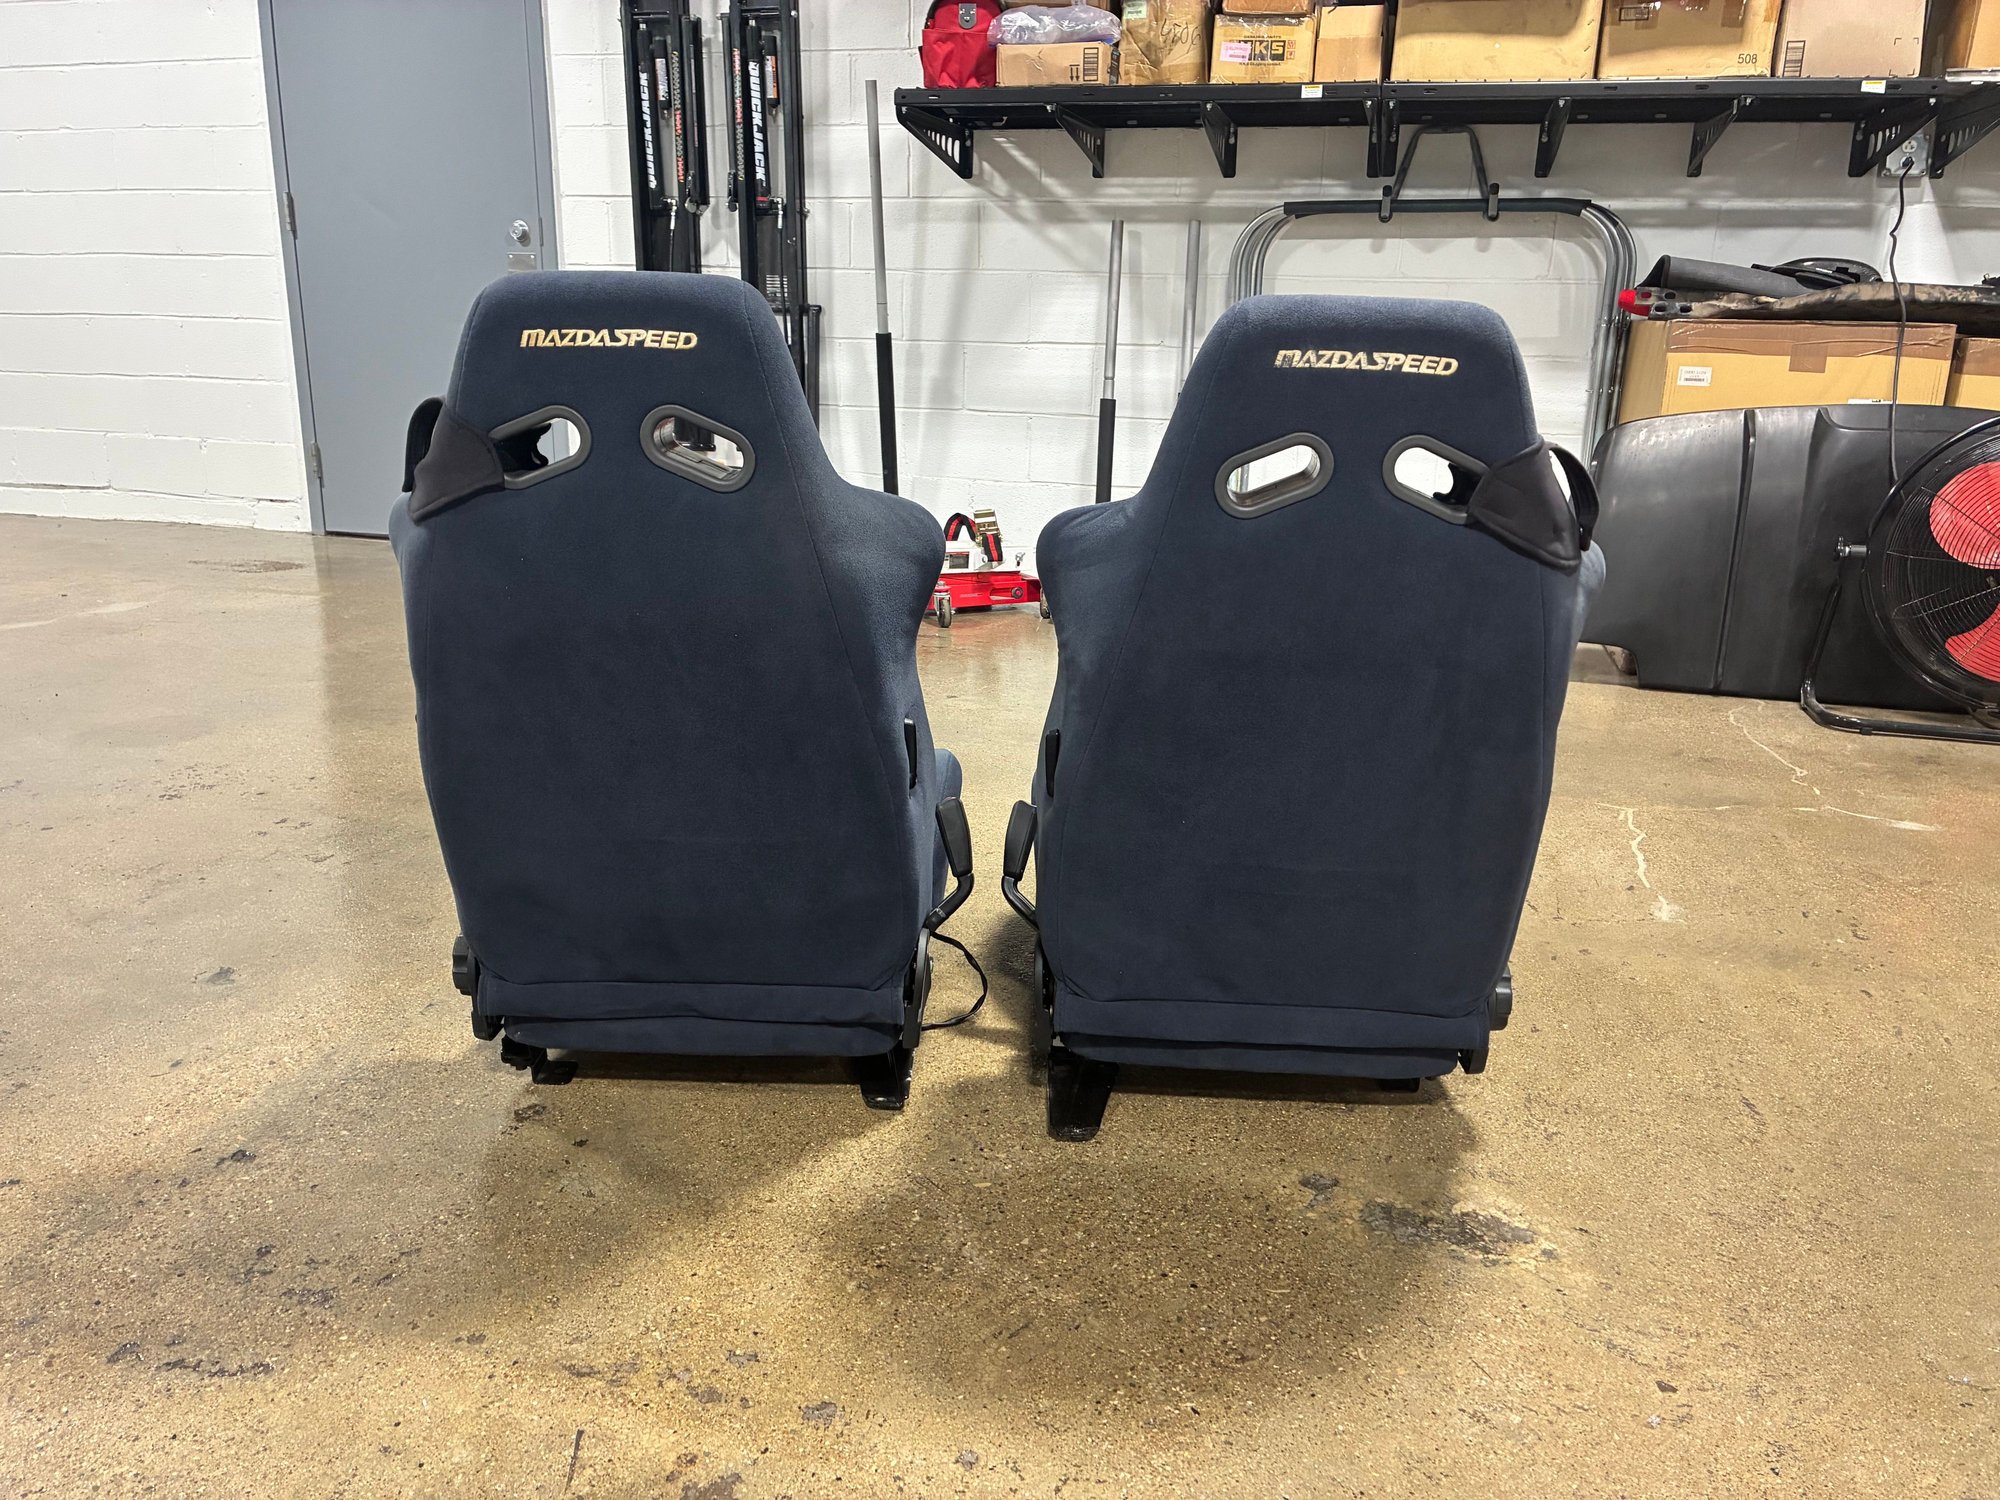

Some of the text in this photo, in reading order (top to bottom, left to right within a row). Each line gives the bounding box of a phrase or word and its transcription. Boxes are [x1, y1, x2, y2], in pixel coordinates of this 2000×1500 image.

[1737, 53, 1758, 65] 508
[639, 71, 657, 189] QUICKJACK
[748, 61, 766, 181] QUICKJACK
[520, 328, 698, 350] MAZDASPEED
[1274, 349, 1459, 376] MAZDASPEED
